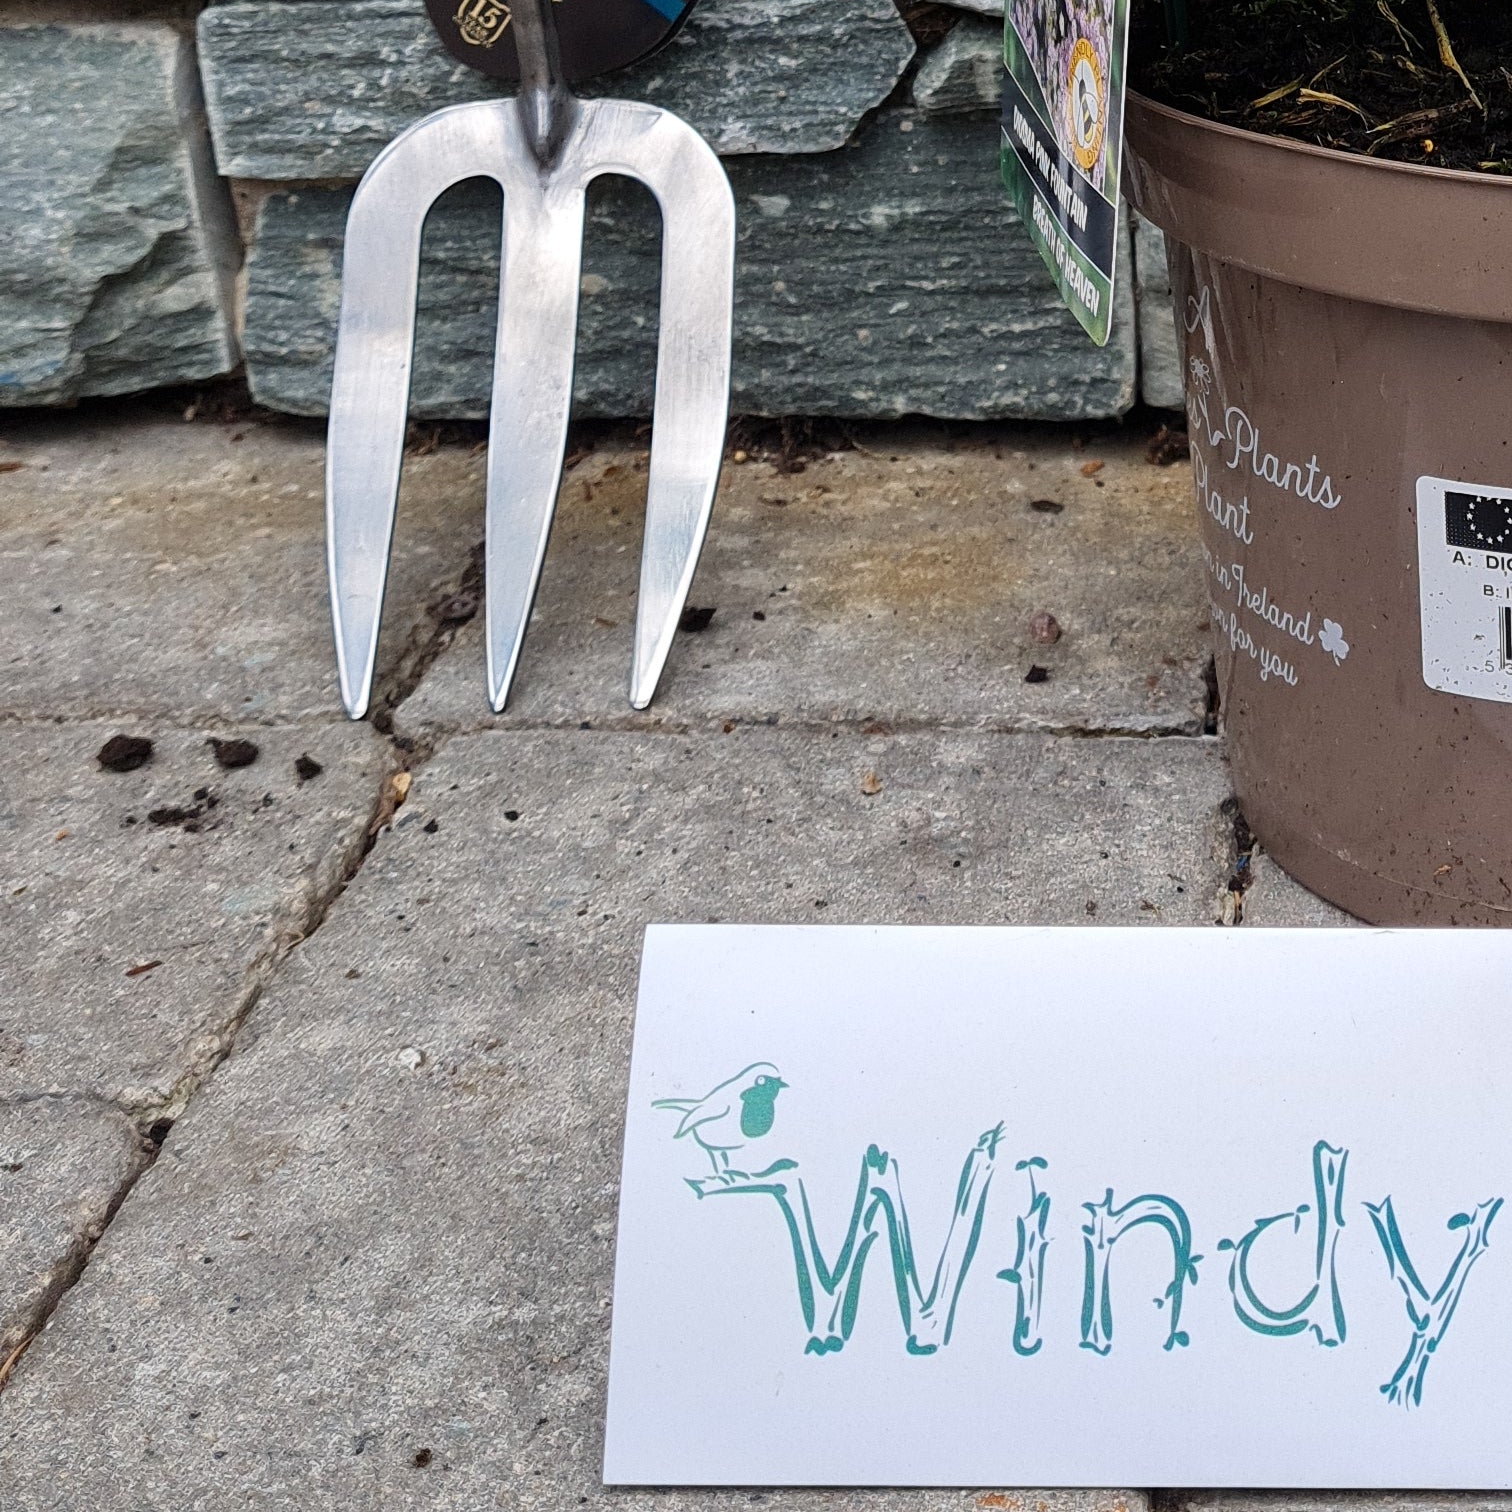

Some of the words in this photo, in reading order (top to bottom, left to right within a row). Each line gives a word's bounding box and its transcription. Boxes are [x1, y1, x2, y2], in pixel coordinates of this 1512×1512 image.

[1035, 139, 1051, 183] PINK
[1049, 162, 1088, 233] FOUNTAIN
[1032, 194, 1057, 256] BREATH
[1055, 235, 1066, 268] OF
[1064, 250, 1100, 319] HEAVEN
[1189, 440, 1254, 546] Plant
[1225, 406, 1342, 509] Plants
[1214, 554, 1232, 591] in
[1231, 563, 1314, 646] Ireland
[1452, 550, 1473, 566] A:
[1483, 584, 1500, 598] B:
[1229, 611, 1258, 660] for
[1259, 649, 1299, 687] you
[1484, 660, 1496, 673] 5
